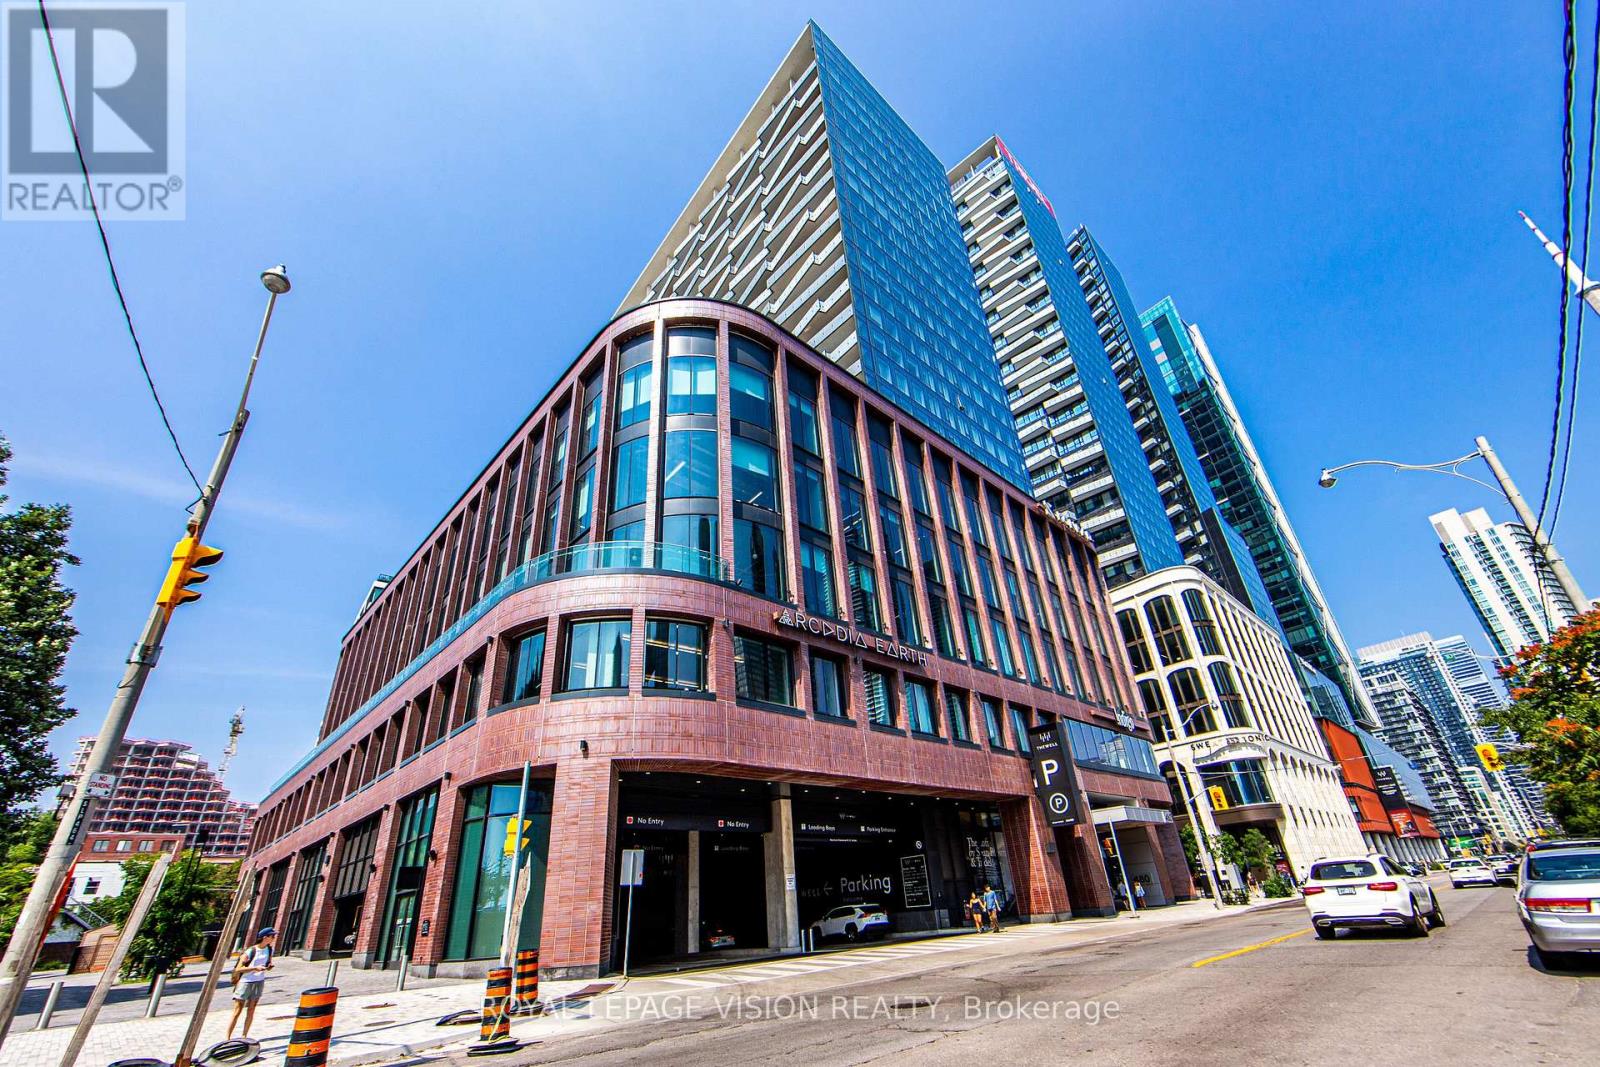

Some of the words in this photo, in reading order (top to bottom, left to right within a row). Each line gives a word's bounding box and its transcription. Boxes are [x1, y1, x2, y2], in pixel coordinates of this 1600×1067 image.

[876, 637, 928, 667] EARTH
[1040, 759, 1059, 786] P
[648, 817, 665, 827] Entry
[840, 874, 891, 894] Parking
